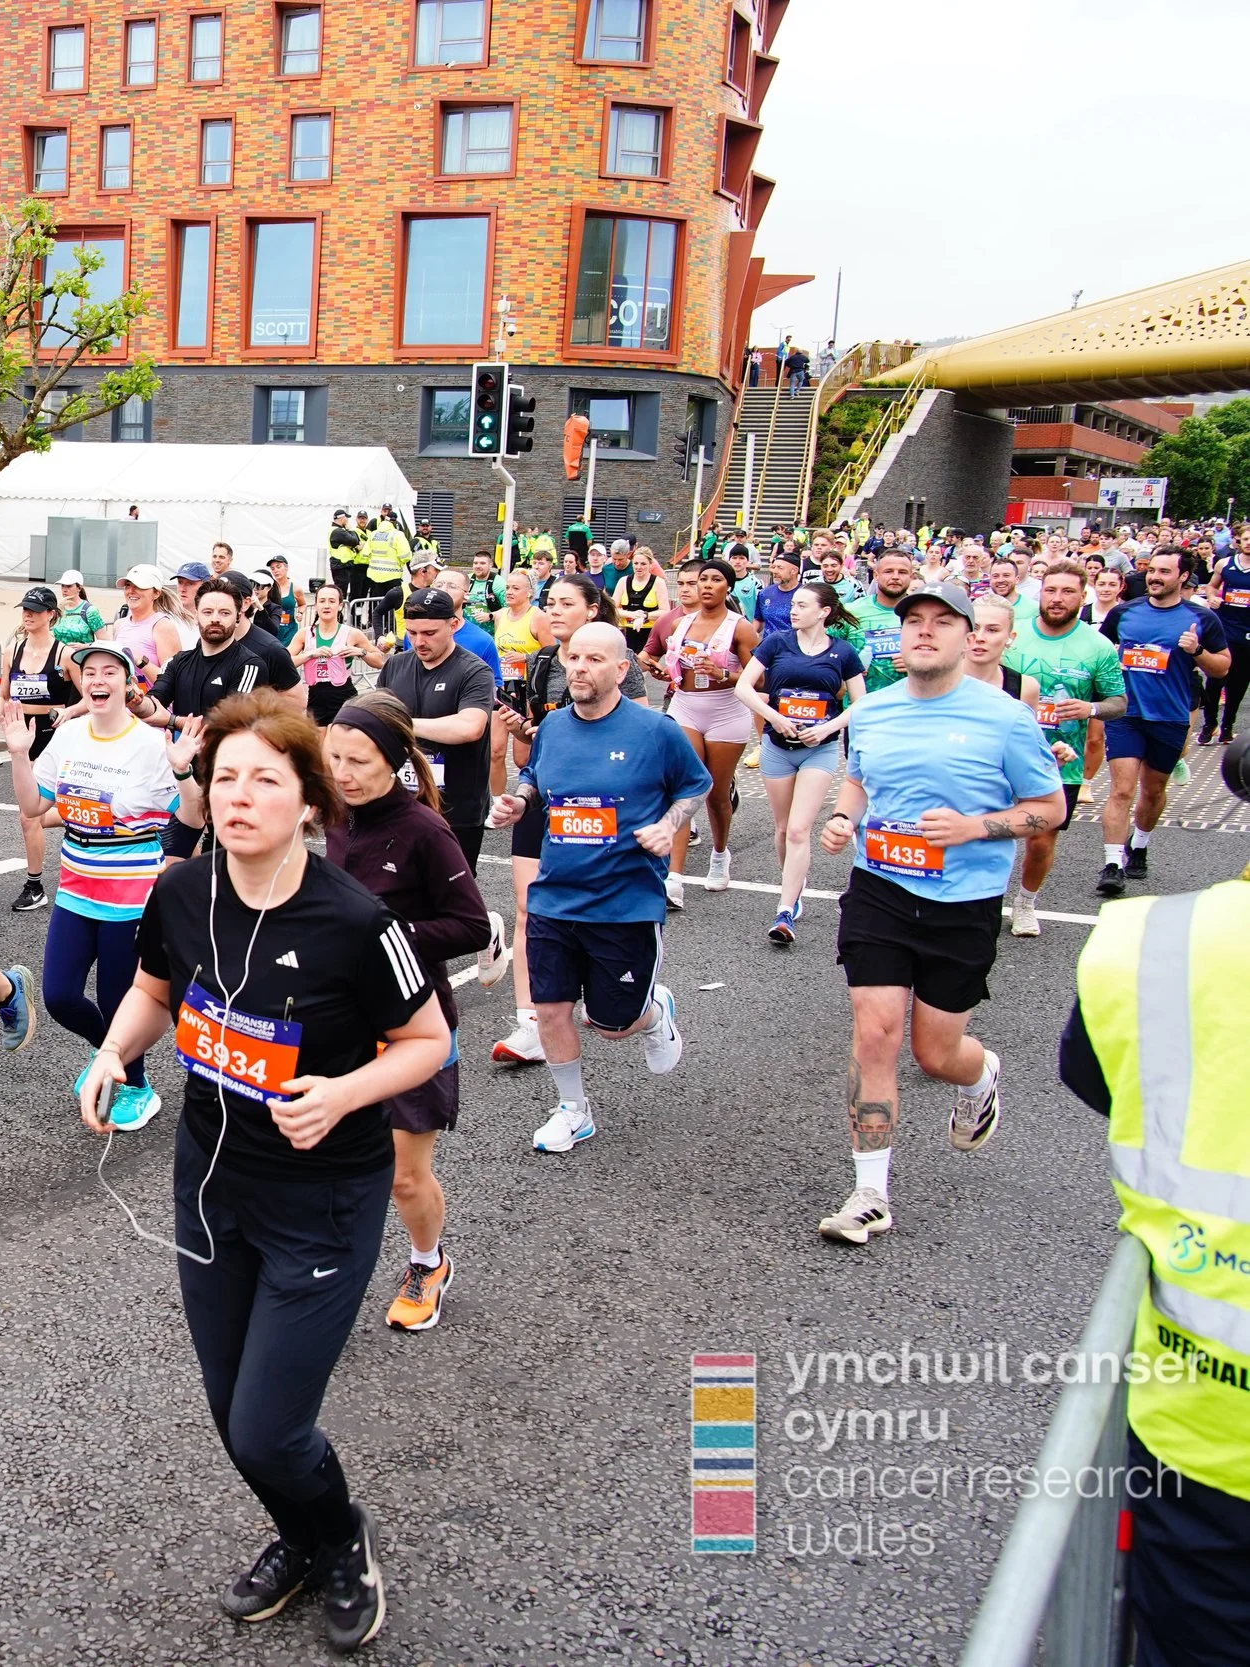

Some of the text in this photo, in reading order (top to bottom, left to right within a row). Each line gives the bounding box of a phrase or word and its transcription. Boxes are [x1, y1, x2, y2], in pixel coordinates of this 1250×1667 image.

[608, 299, 667, 328] COTT
[255, 321, 307, 336] SCOTT
[1131, 655, 1158, 668] 1356
[17, 687, 41, 696] 2722
[787, 704, 817, 717] 6456
[72, 760, 102, 771] ymchwil
[70, 768, 93, 779] cymru
[56, 796, 81, 807] BETHAN
[66, 806, 100, 825] 2393
[551, 809, 575, 817] BARRY
[562, 817, 603, 834] 6065
[866, 831, 887, 842] PAUL
[879, 843, 926, 866] 1435
[180, 1009, 210, 1035] ANYA
[230, 1011, 276, 1032] SWANSEA
[196, 1033, 267, 1085] 5934
[1158, 1325, 1250, 1392] OFFICIAL
